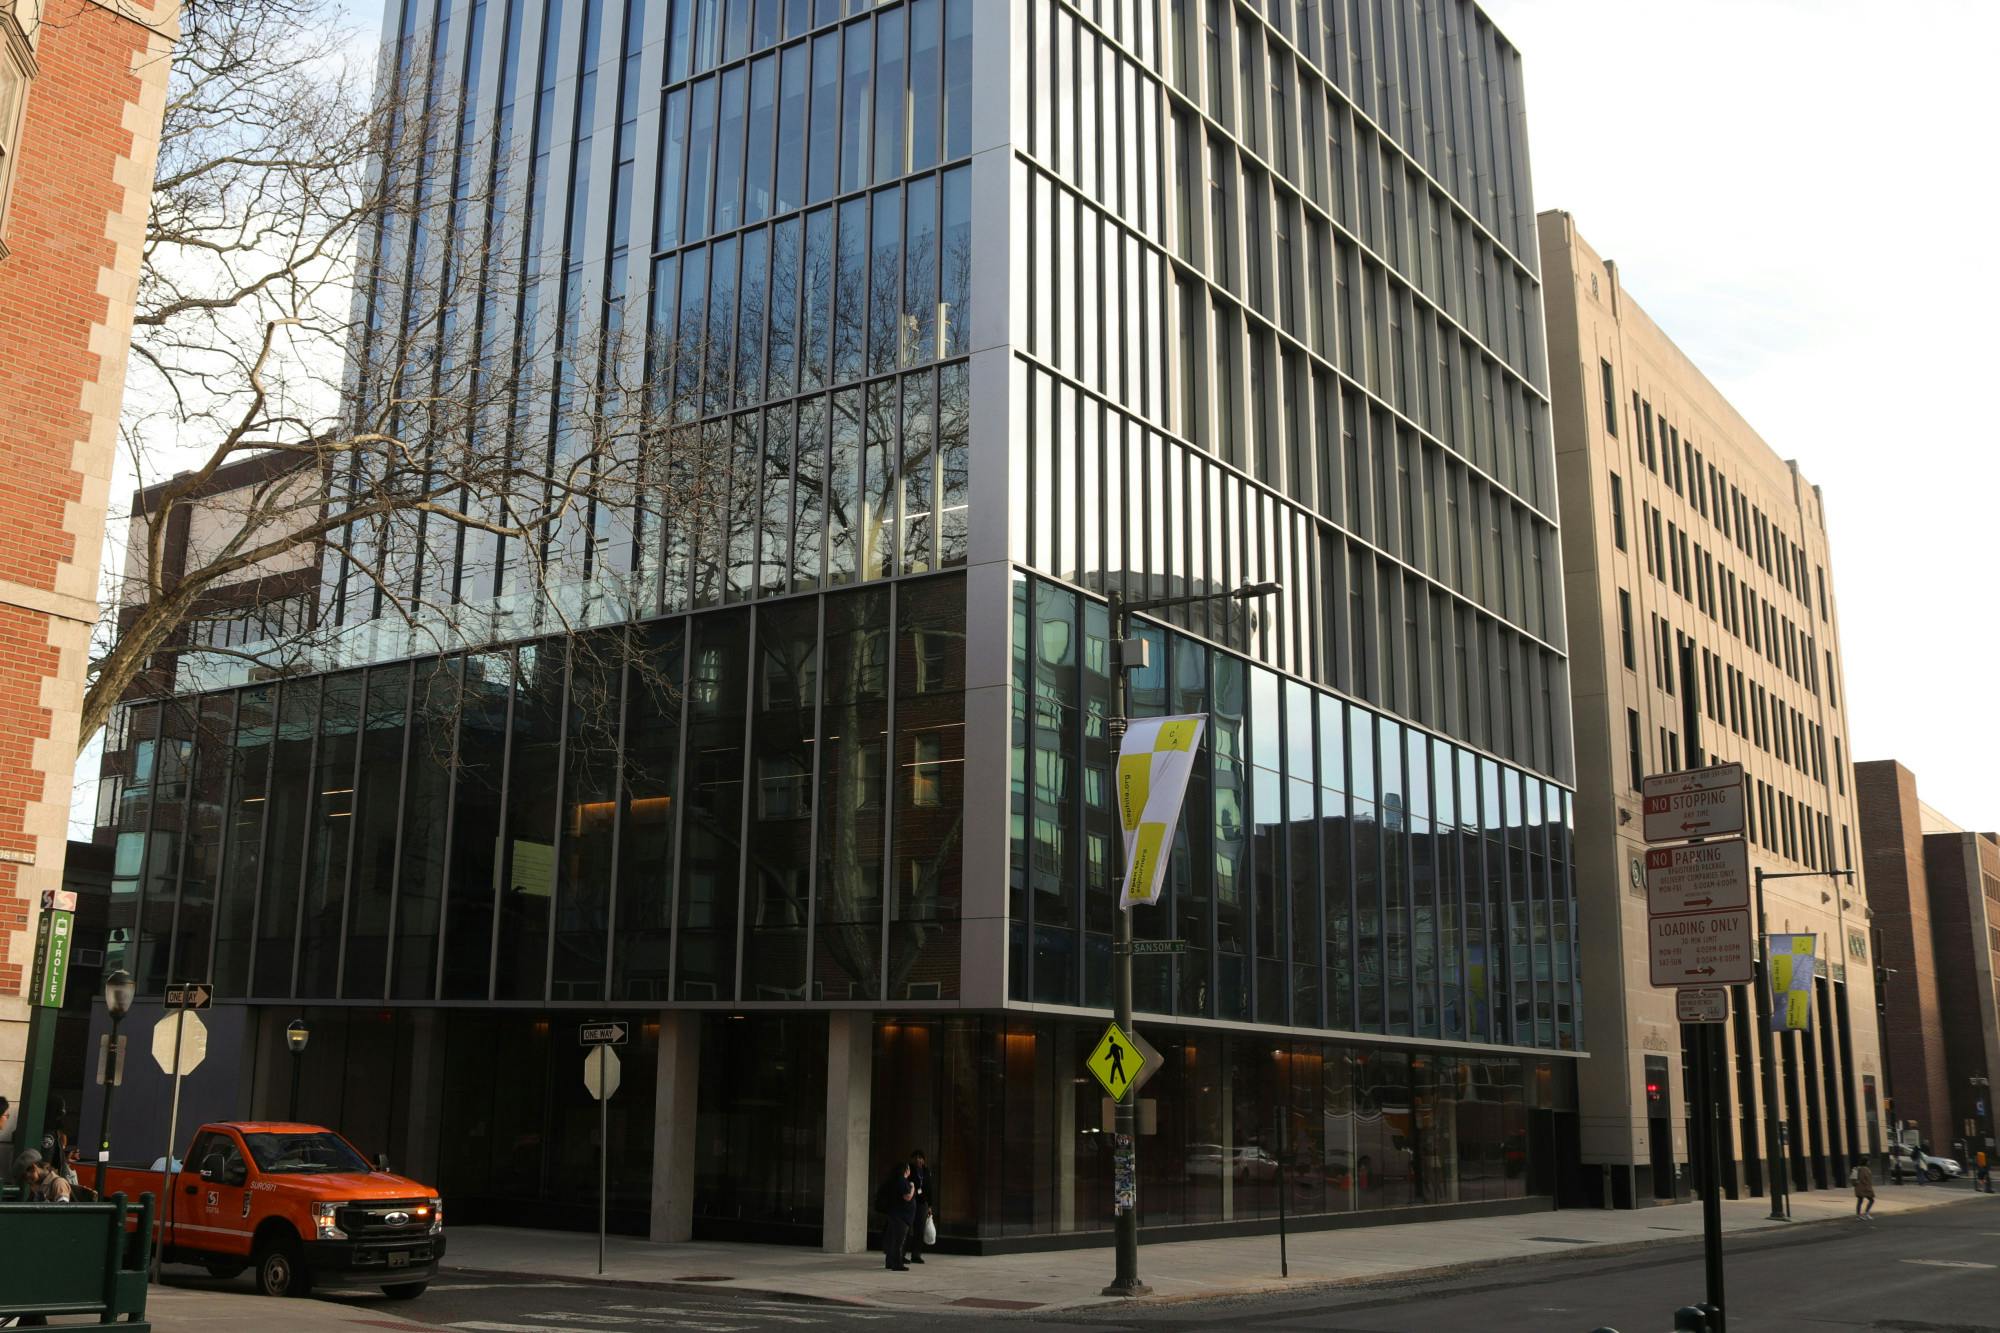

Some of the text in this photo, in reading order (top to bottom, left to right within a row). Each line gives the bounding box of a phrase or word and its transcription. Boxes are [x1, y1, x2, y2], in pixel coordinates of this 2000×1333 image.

[1652, 790, 1726, 811] NO STOPPING
[1697, 809, 1709, 817] TIME
[1652, 848, 1721, 866] NO PARKING
[1659, 917, 1739, 937] LOADING ONLY
[1134, 943, 1184, 952] SANSOM ST
[33, 938, 45, 1001] TROLLEY
[49, 940, 64, 1002] TROLLEY
[169, 991, 183, 1002] ONE
[585, 1030, 613, 1039] ONE WAY
